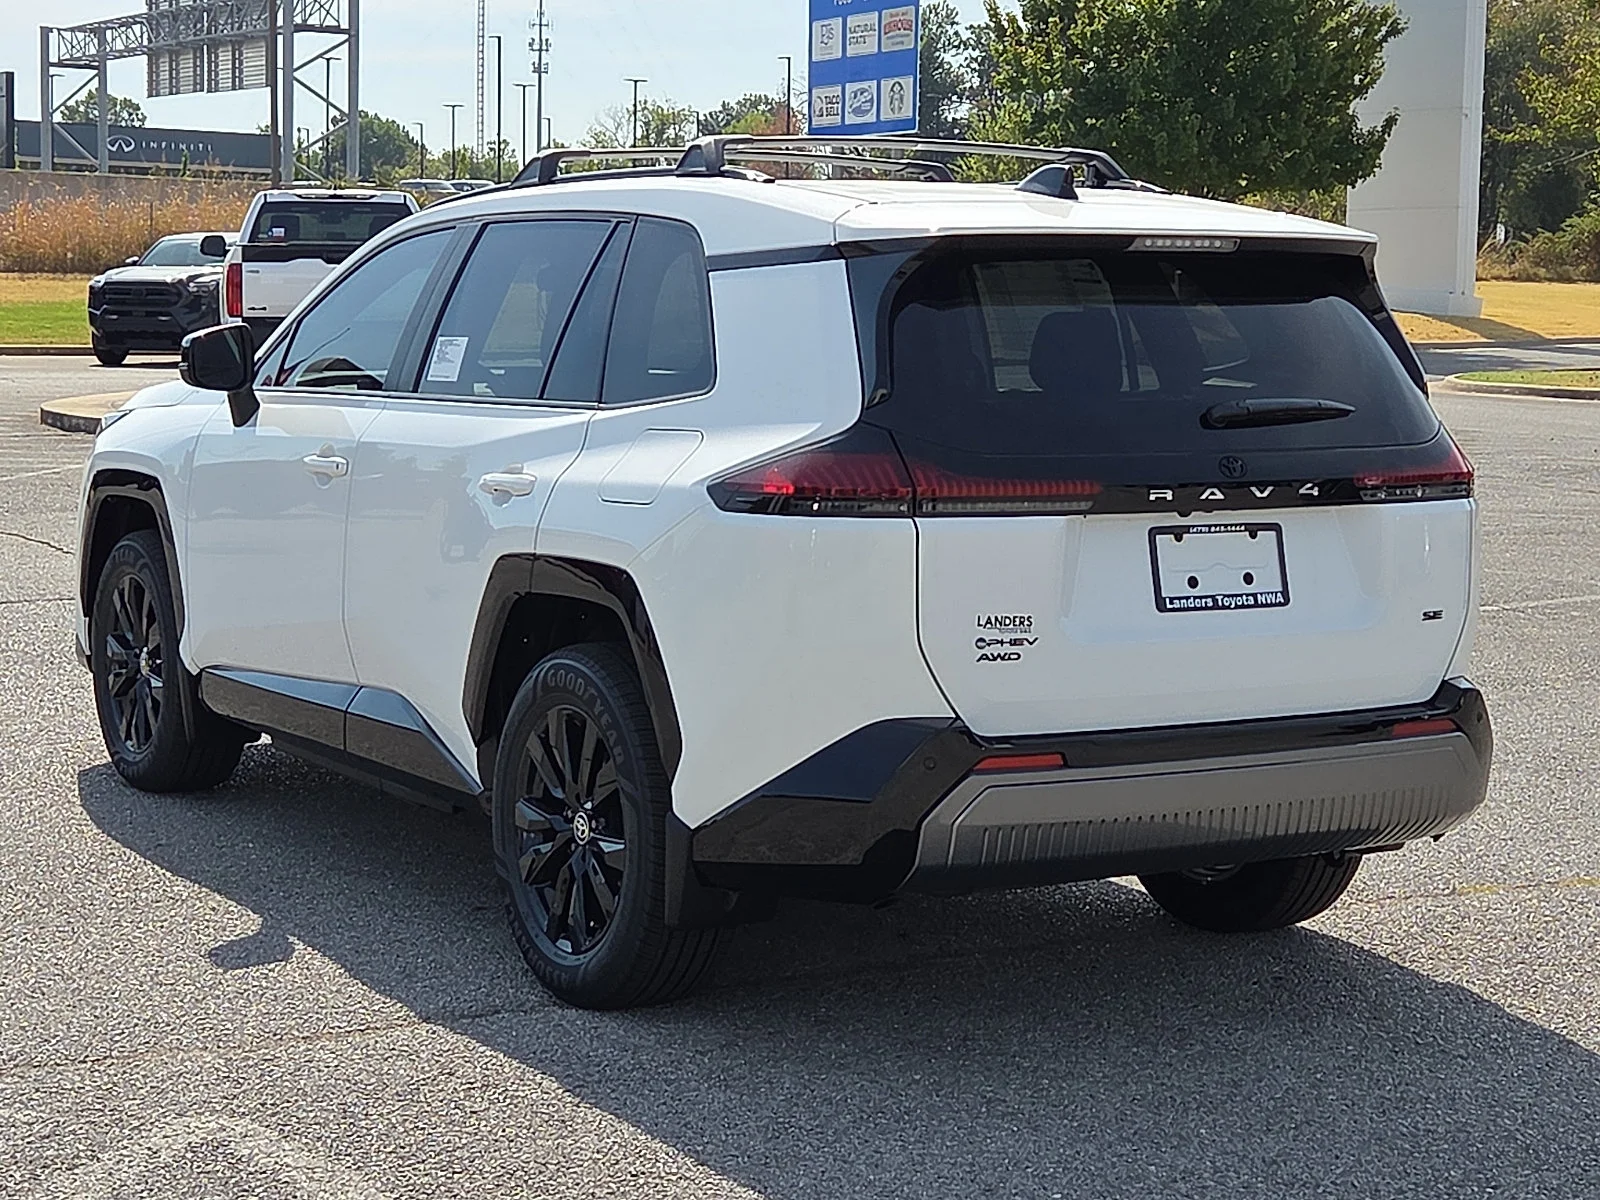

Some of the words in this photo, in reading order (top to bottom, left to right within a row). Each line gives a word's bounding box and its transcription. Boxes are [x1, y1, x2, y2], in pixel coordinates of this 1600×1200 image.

[824, 94, 840, 105] TACO
[825, 106, 840, 117] BELL
[141, 140, 213, 152] INFINITI
[1148, 483, 1320, 501] RAV4
[1165, 596, 1213, 609] Landers
[1215, 595, 1255, 608] Toyota
[1257, 592, 1285, 605] NWA
[1421, 609, 1444, 621] SE
[976, 614, 1033, 629] LANDERS
[976, 652, 1022, 663] AWD
[547, 669, 625, 766] GOODYEAR
